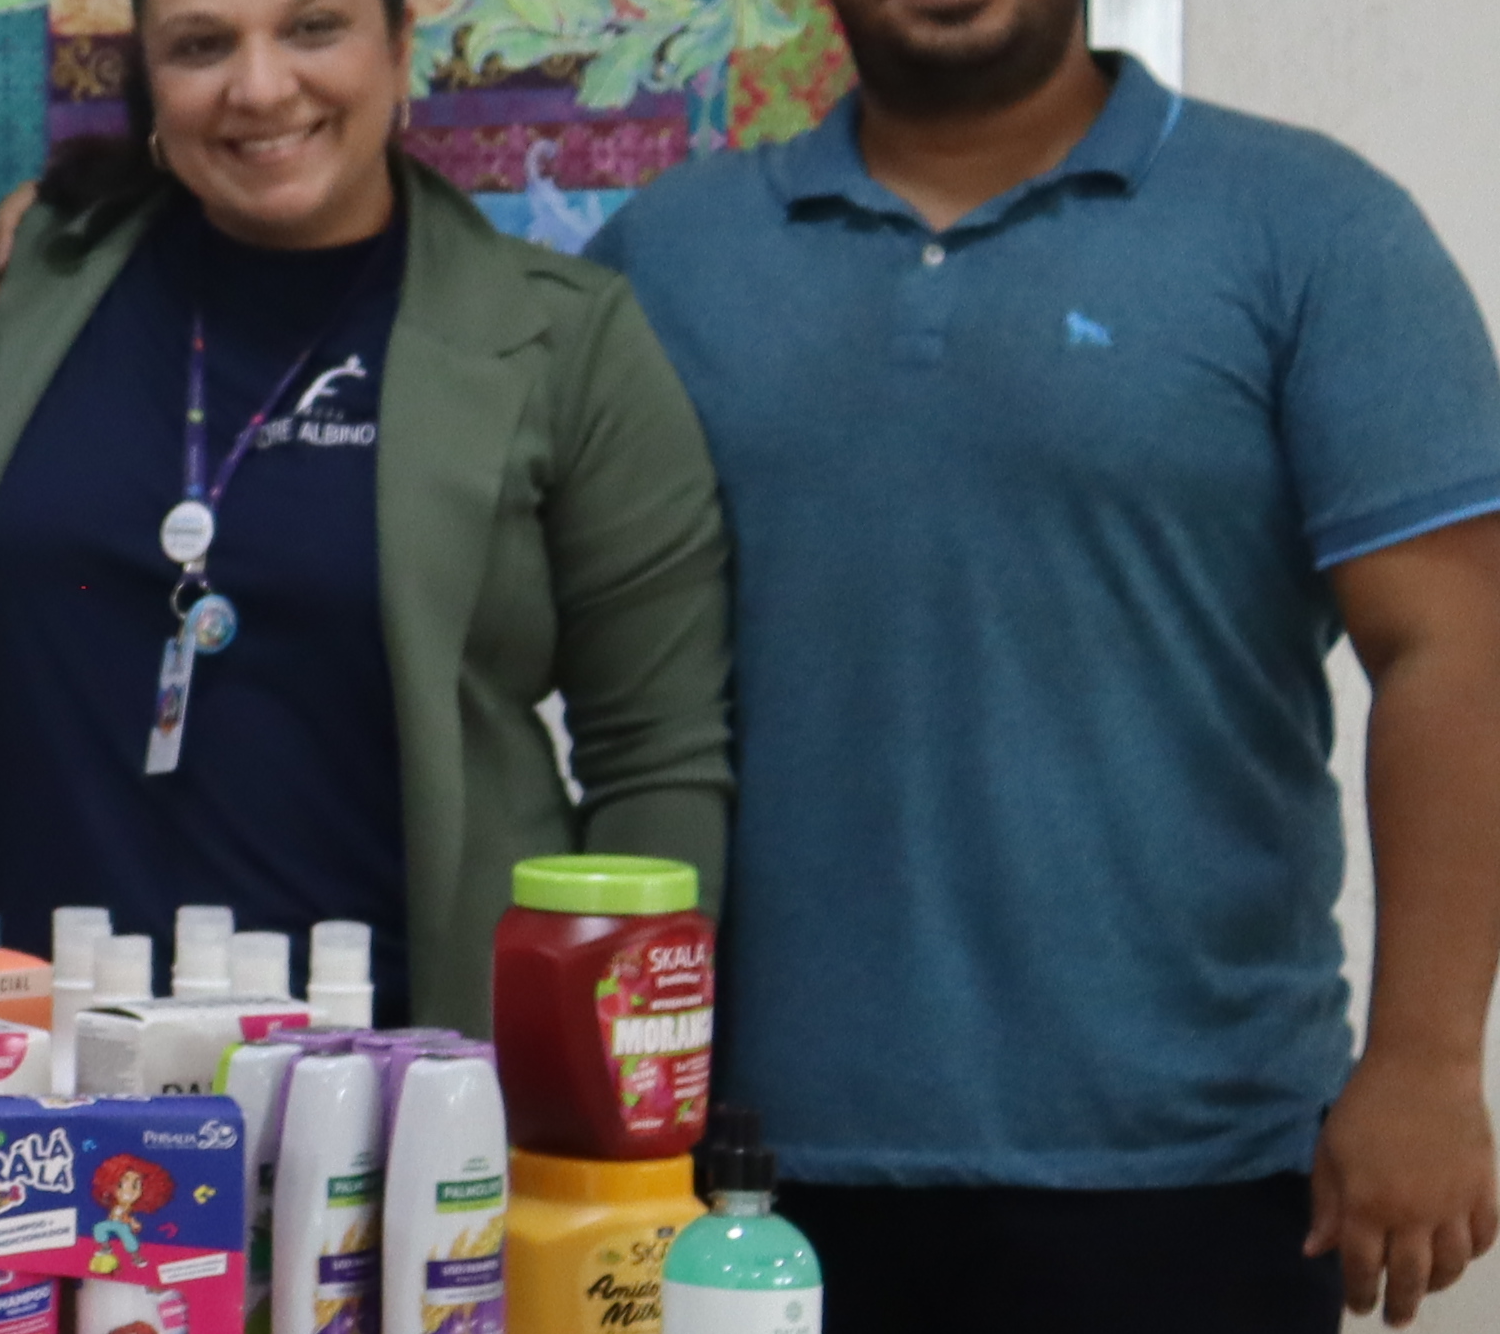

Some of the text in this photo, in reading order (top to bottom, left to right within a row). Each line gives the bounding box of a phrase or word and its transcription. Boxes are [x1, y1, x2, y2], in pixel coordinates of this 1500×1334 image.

[299, 422, 376, 446] ALBINO
[650, 943, 706, 973] SKALA
[586, 1273, 661, 1300] Amido
